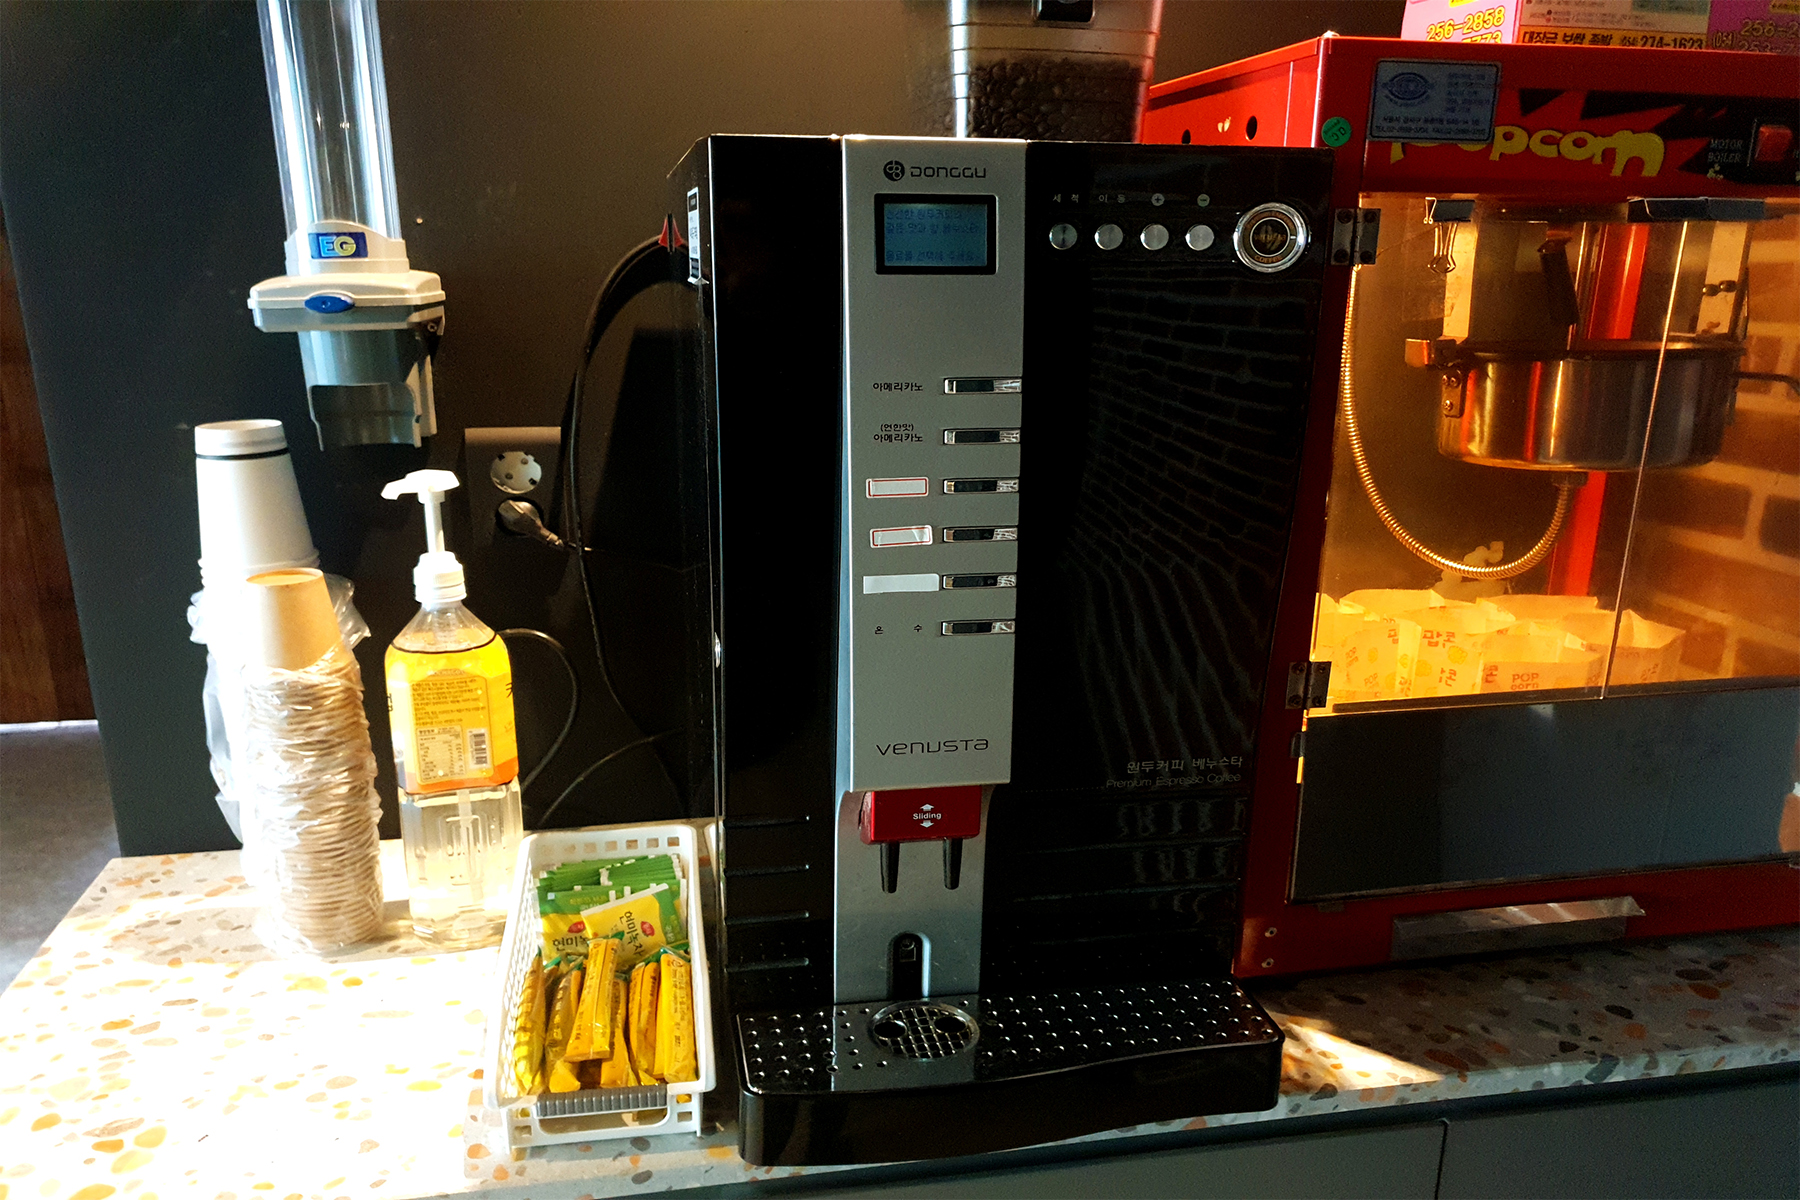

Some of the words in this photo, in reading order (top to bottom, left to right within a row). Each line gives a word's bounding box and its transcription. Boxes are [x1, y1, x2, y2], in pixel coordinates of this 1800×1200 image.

[1426, 5, 1505, 41] 256-2858
[1522, 31, 1558, 44] 대장금
[1710, 139, 1743, 149] MOTOR
[910, 166, 987, 178] DONGGU
[318, 235, 357, 257] EG
[872, 382, 923, 392] 아메리카노
[880, 423, 914, 432] (연한맛)
[873, 433, 923, 443] 아메리카노
[1512, 672, 1539, 683] POP
[1509, 683, 1539, 691] corn
[1127, 759, 1185, 774] 원두커피
[1192, 756, 1243, 770] 베누스타
[1106, 777, 1152, 788] Premium
[1156, 774, 1204, 787] Espresso
[1207, 773, 1242, 784] Coffee
[912, 812, 942, 821] Sliding
